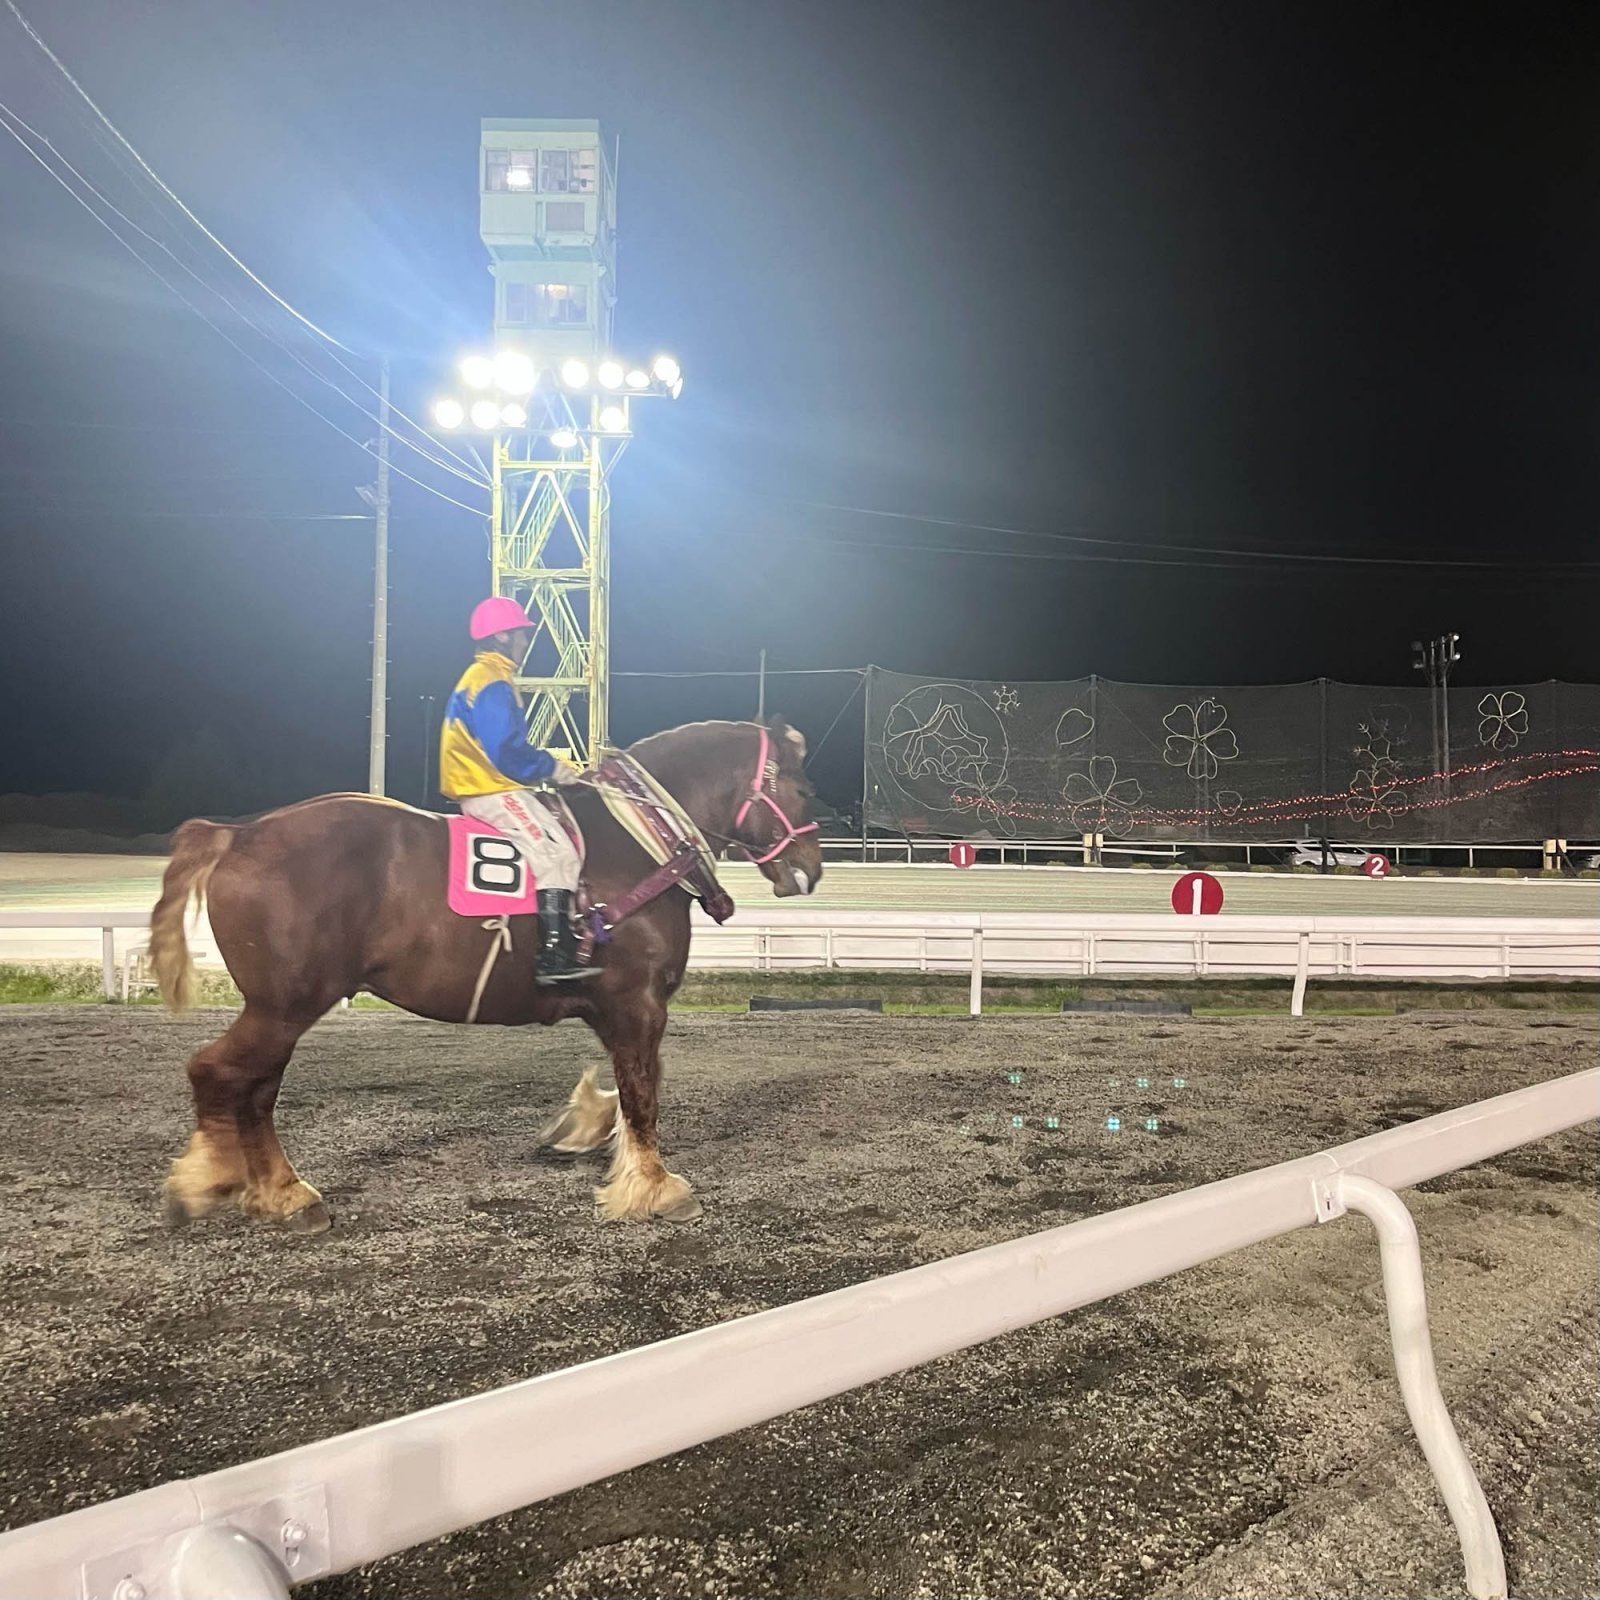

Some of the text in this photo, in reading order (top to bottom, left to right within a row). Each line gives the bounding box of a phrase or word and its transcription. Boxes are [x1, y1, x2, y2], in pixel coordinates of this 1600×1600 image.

[472, 836, 521, 893] 8
[959, 845, 966, 865] 1
[1371, 857, 1384, 875] 2
[1192, 878, 1203, 915] 1
